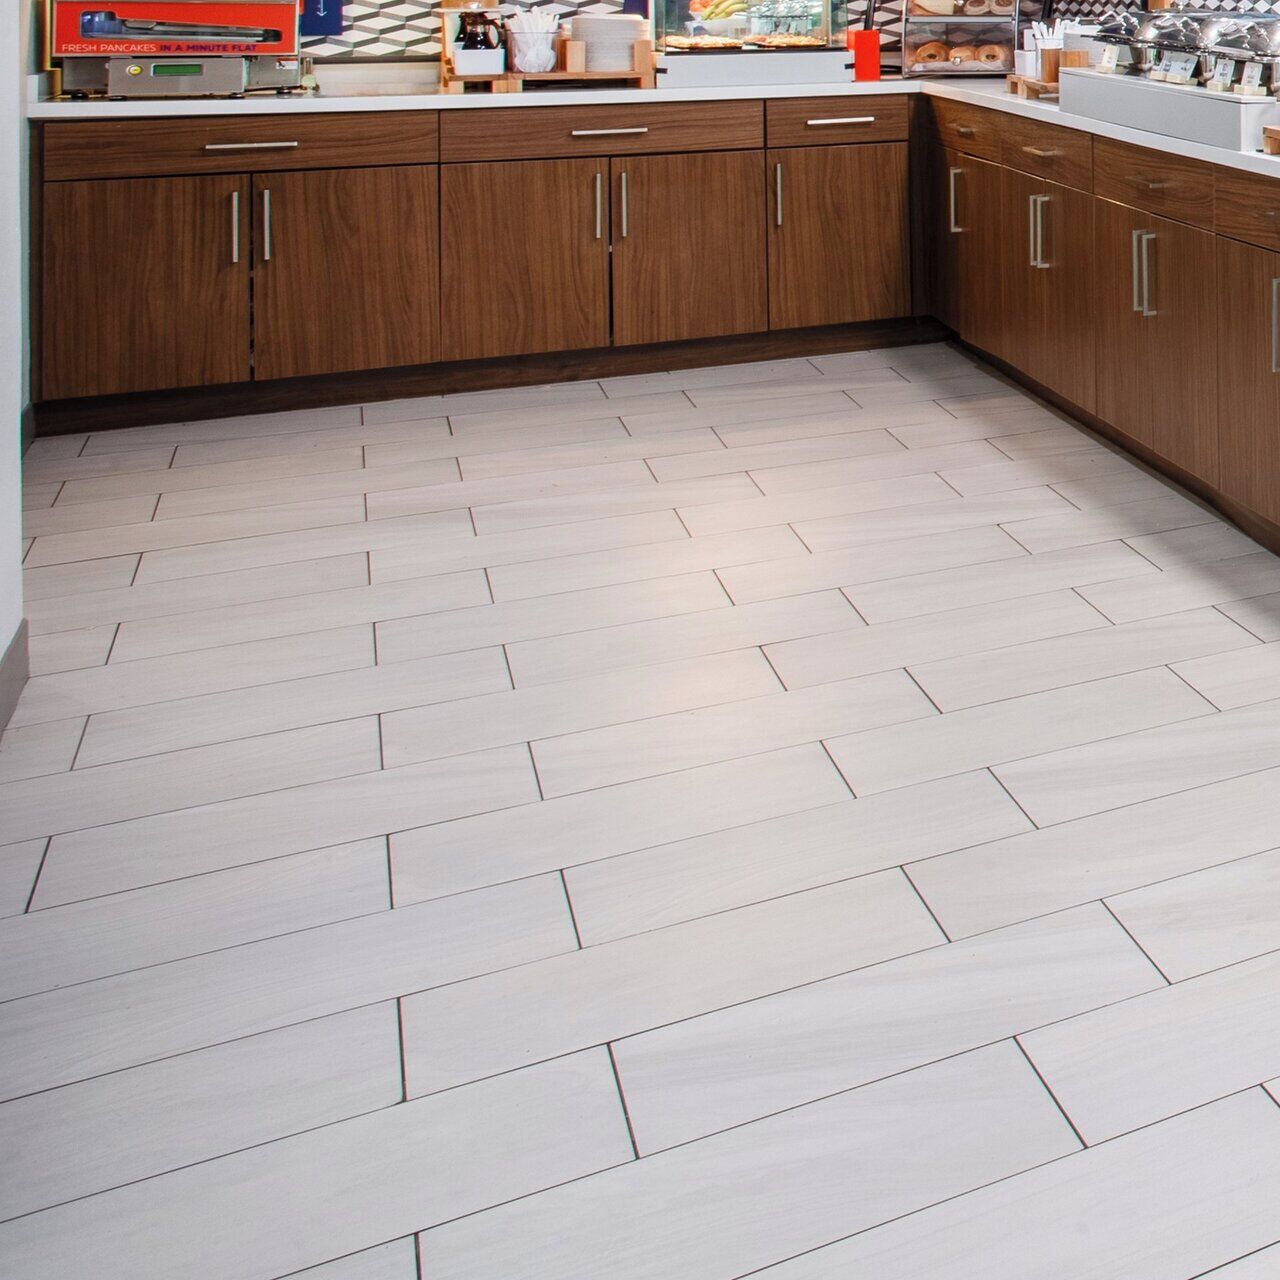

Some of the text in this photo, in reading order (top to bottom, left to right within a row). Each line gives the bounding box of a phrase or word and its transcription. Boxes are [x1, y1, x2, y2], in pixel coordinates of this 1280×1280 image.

[62, 44, 257, 53] FRESH PANCAKES IN A MINUTE FLAT
